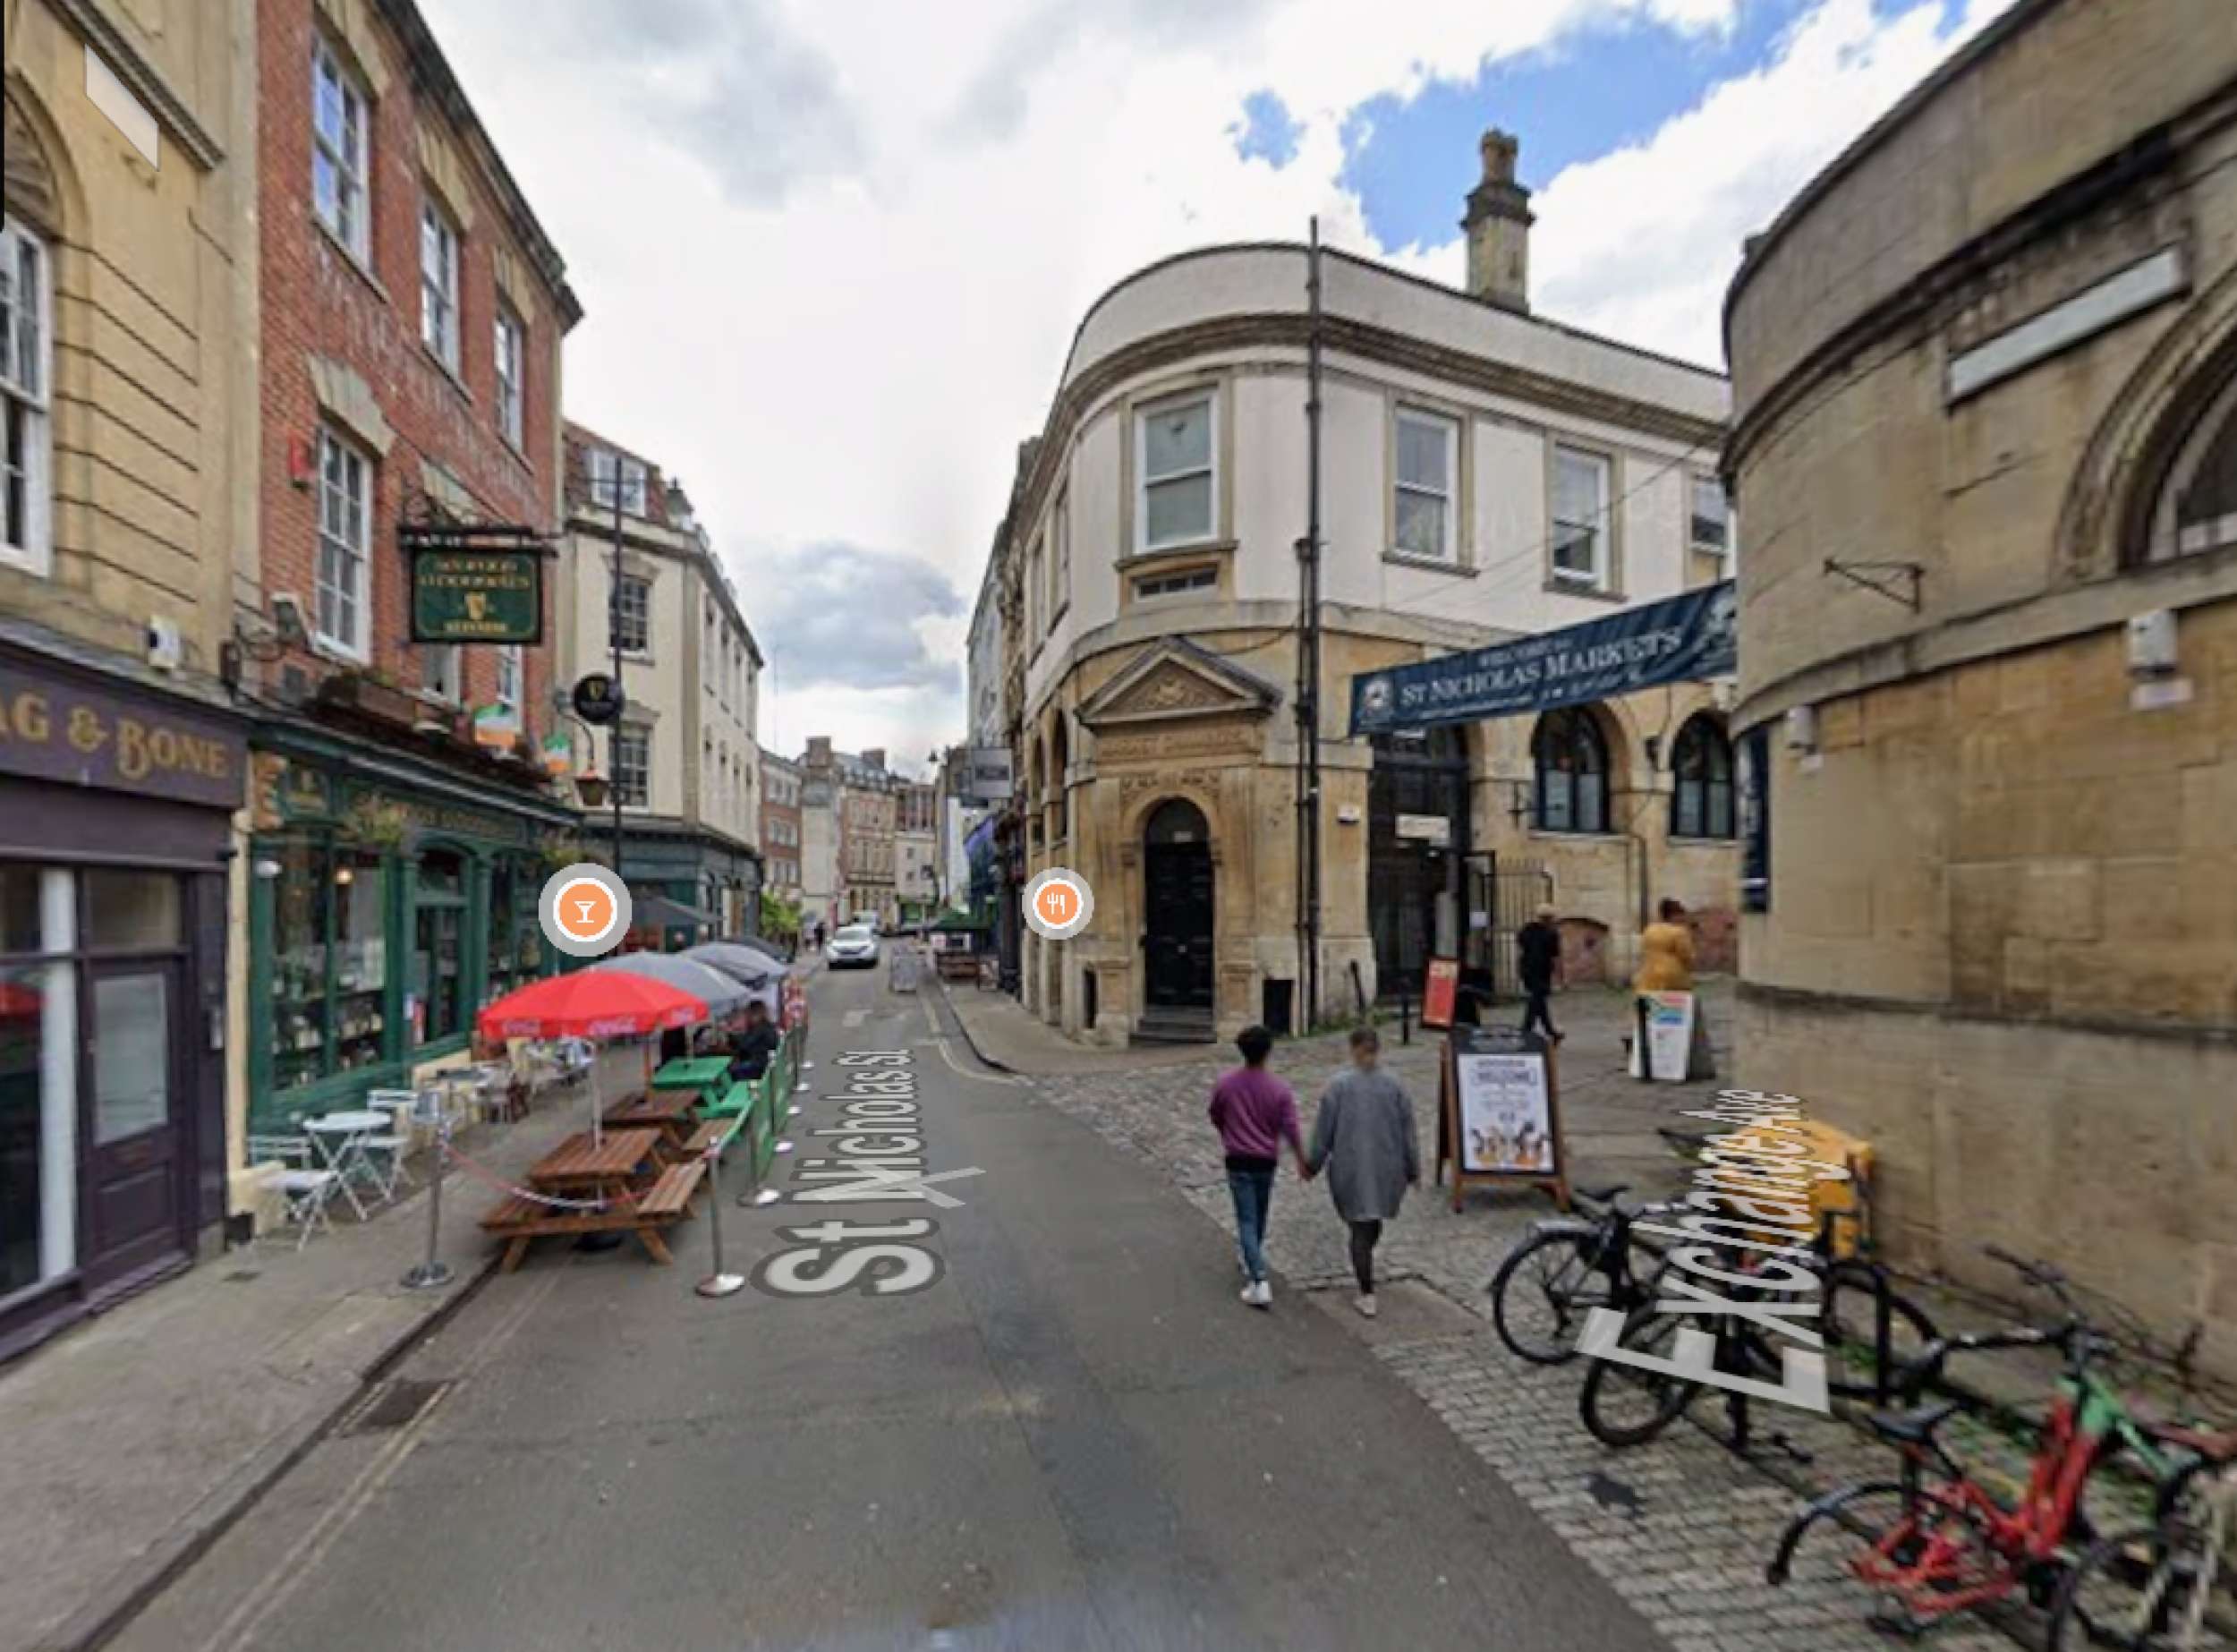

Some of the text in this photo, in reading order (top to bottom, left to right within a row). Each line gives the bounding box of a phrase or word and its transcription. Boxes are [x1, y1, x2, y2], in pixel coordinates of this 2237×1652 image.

[1432, 663, 1542, 703] NICHOLAS
[1544, 630, 1682, 677] MARKETS
[68, 706, 107, 754] &
[118, 720, 227, 779] BONE
